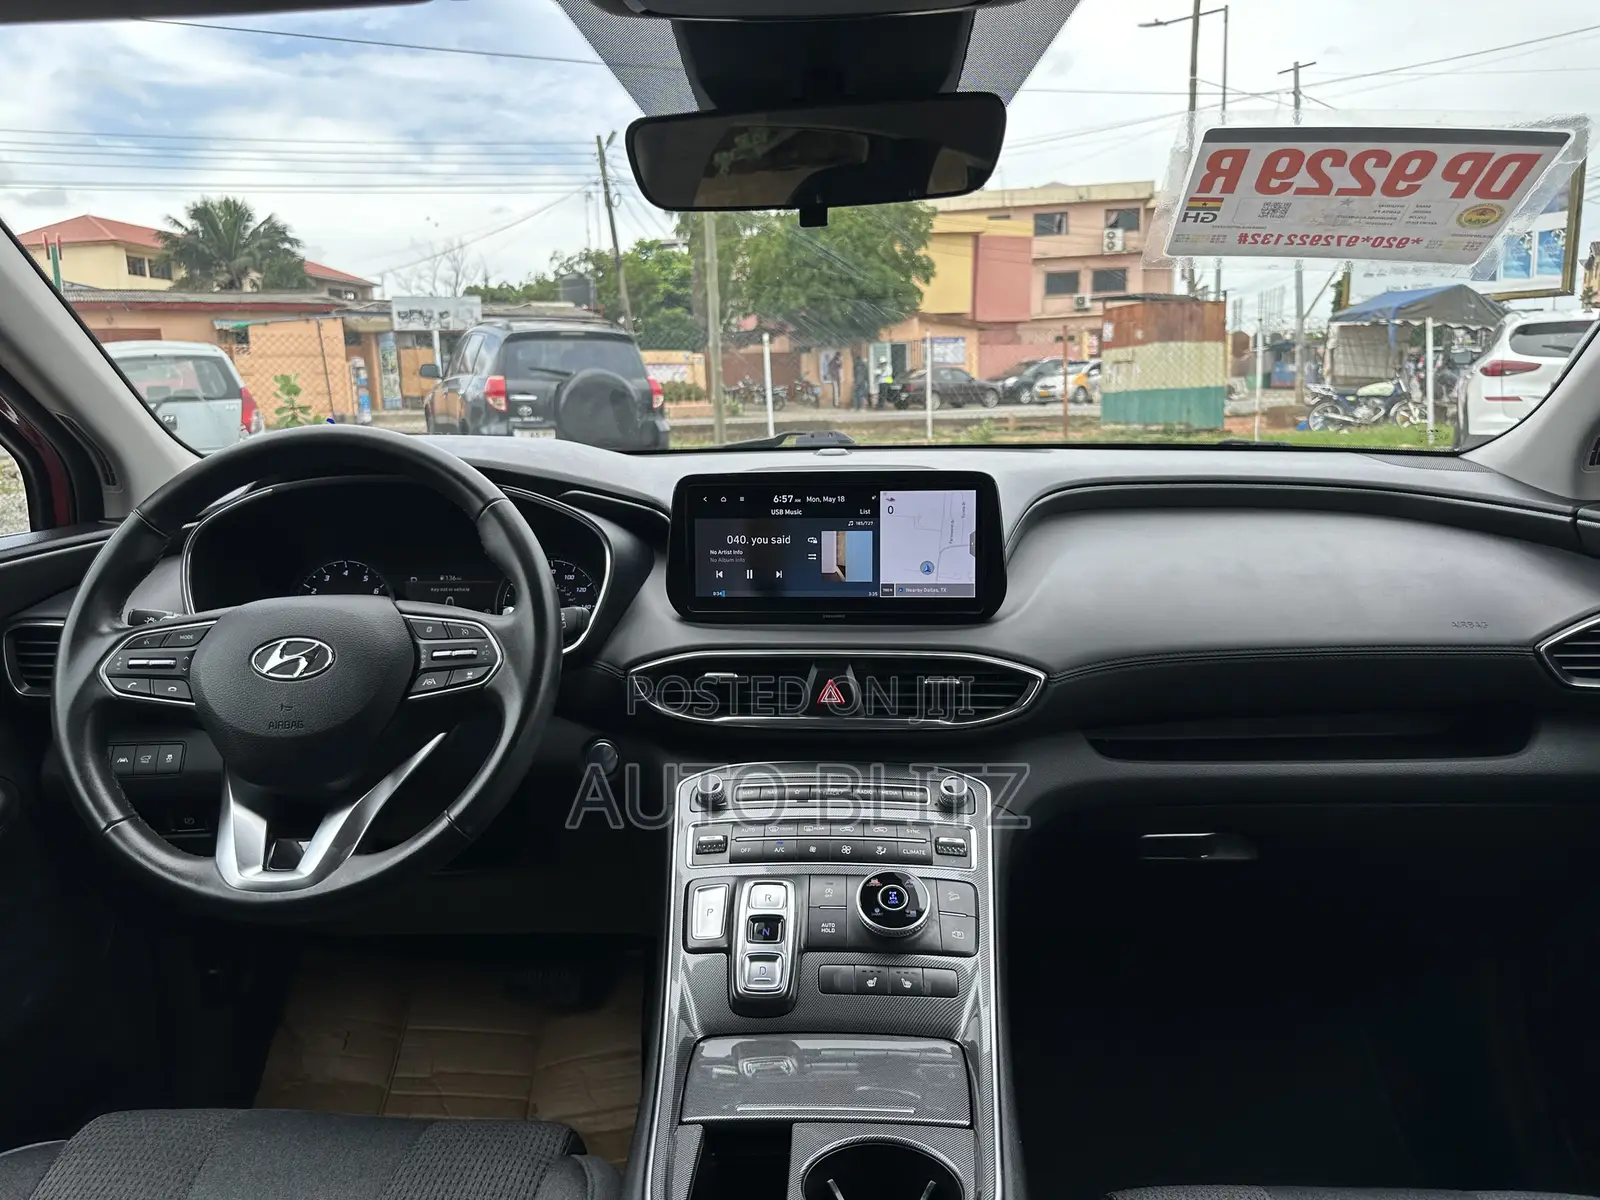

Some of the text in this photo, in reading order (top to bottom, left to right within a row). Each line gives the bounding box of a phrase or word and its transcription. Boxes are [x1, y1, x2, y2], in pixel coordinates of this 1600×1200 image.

[773, 495, 793, 503] 6:57
[888, 505, 894, 514] 0
[727, 535, 791, 546] 040. you said
[1452, 621, 1489, 629] AIRBAG
[268, 720, 304, 730] AIRBAG
[764, 894, 772, 902] R
[706, 908, 714, 917] P
[762, 928, 770, 936] N
[759, 966, 767, 976] D
